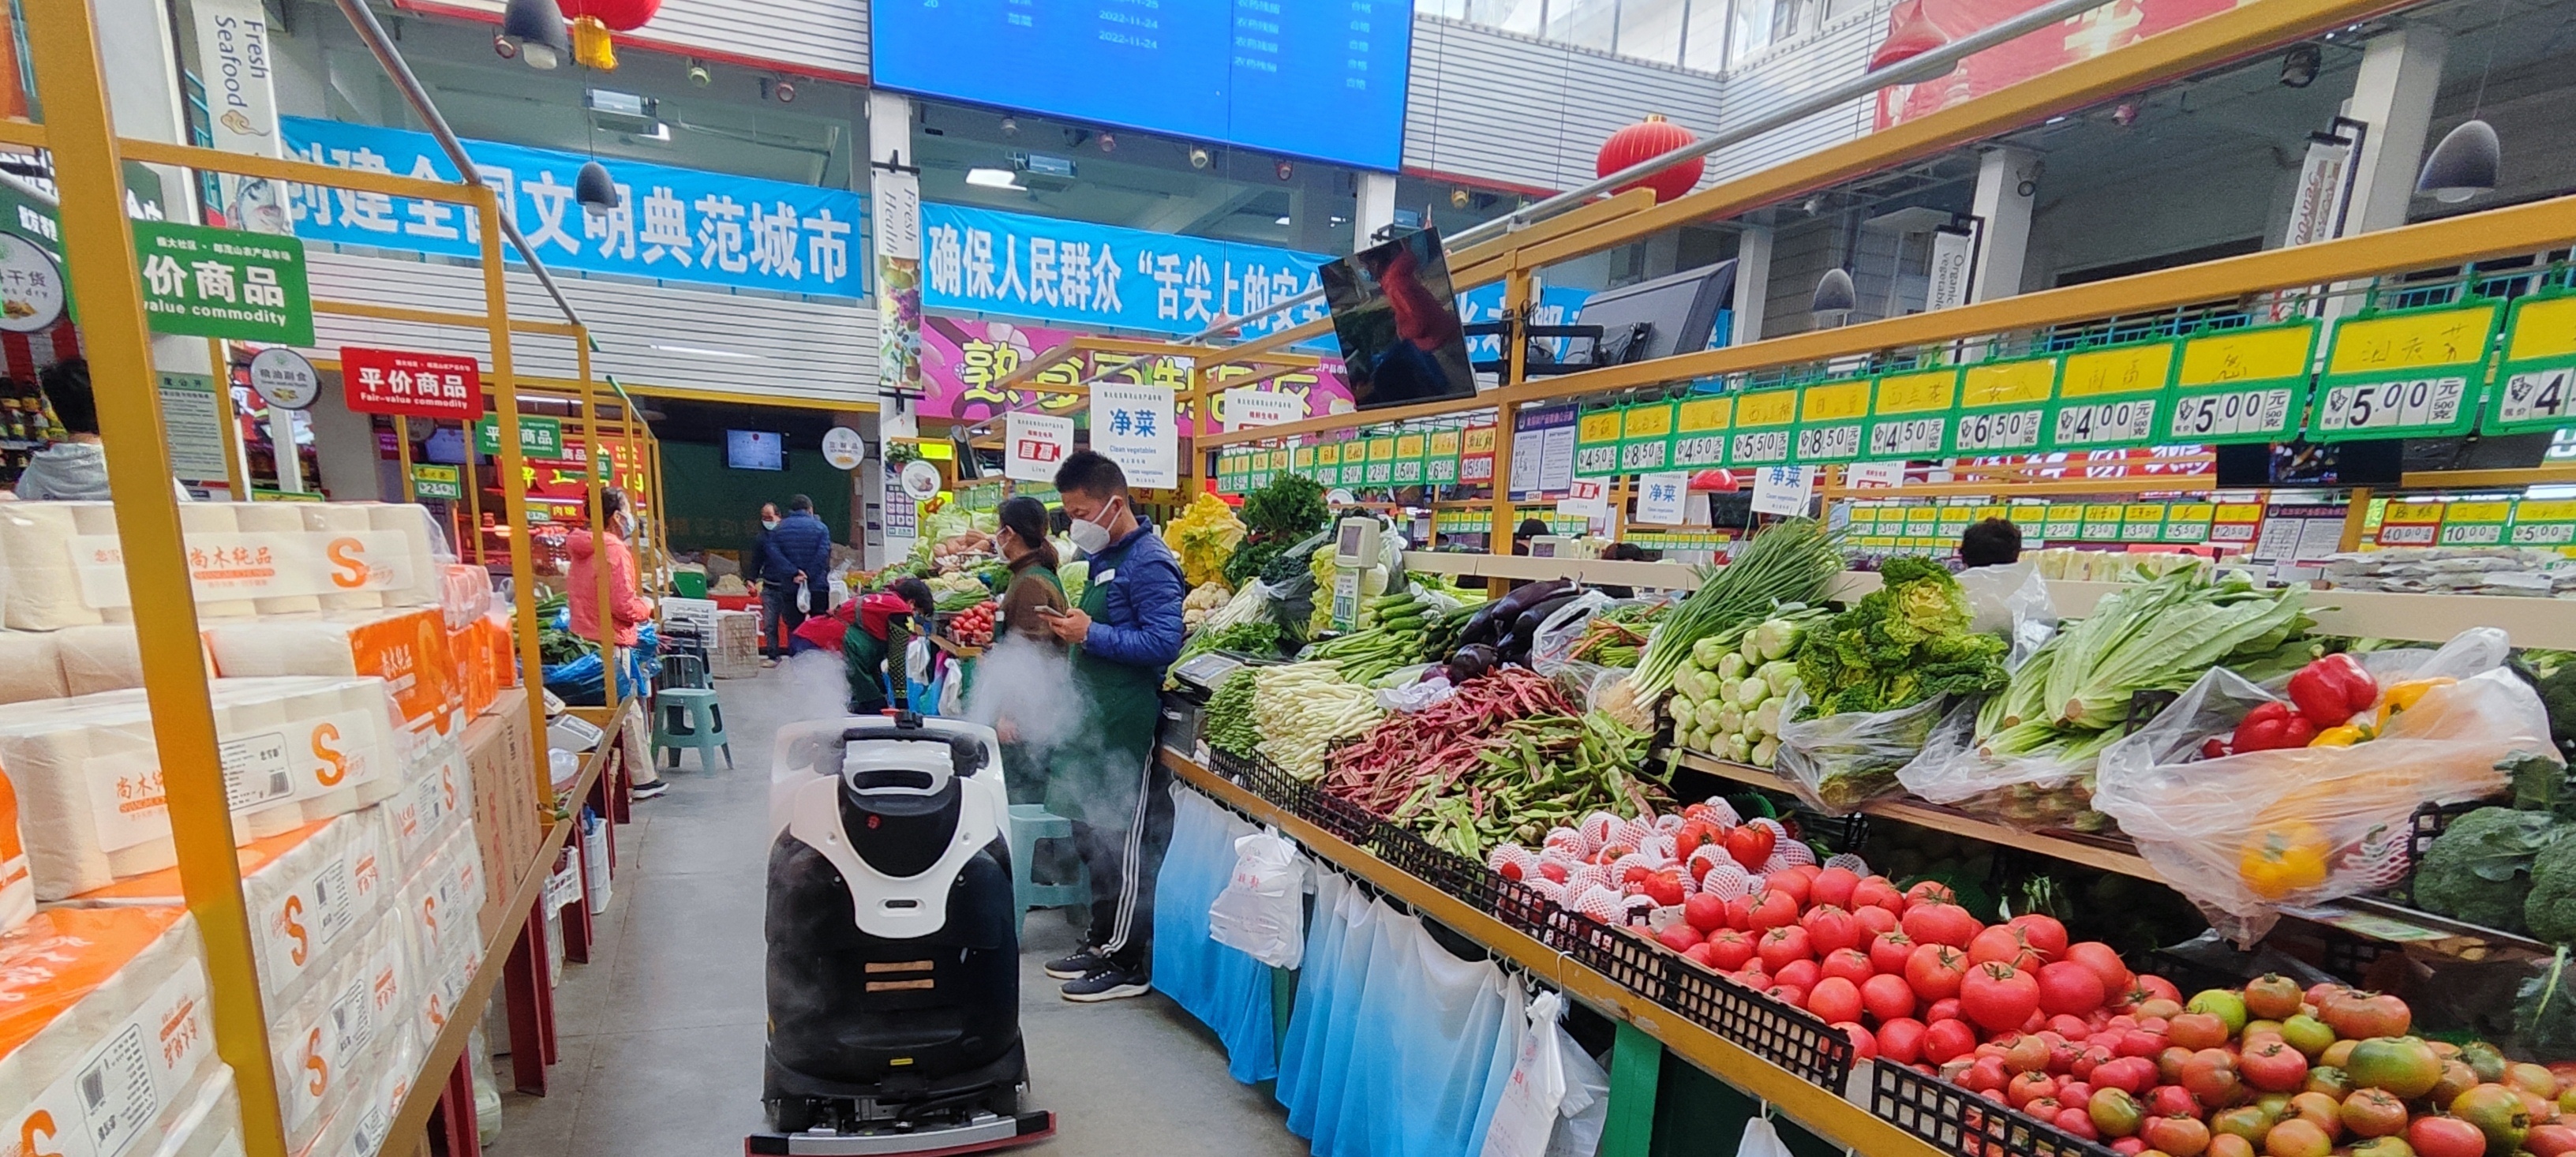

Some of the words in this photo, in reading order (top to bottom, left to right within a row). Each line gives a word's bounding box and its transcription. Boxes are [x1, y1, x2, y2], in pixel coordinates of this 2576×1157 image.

[1099, 10, 1158, 28] 2022-11-24
[244, 20, 266, 80] Fresh
[1099, 31, 1158, 49] 2022-11-24
[215, 15, 247, 108] Seafood
[287, 142, 851, 284] 创建全国文明典范城市
[885, 190, 898, 254] Health
[904, 188, 917, 242] Fresh
[144, 253, 285, 308] 价商品
[1934, 252, 1950, 310] vegetable
[1947, 254, 1965, 305] Organic
[192, 305, 286, 327] commodity
[358, 366, 468, 399] 平价商品
[2267, 391, 2286, 405] 元
[2439, 380, 2460, 395] 元
[414, 398, 468, 410] commodity
[2195, 393, 2260, 433] 5.00
[2349, 381, 2428, 427] 5.00
[485, 425, 552, 446] 平商品
[1108, 407, 1157, 438] 净菜
[1885, 421, 1926, 452] 4.50
[1975, 414, 2020, 443] 6.50
[2076, 404, 2129, 440] 4.00
[1109, 444, 1126, 453] Clean
[1631, 442, 1655, 466] 8.50
[1685, 438, 1712, 462] 4.50
[1744, 433, 1775, 458] 5.50
[1811, 428, 1844, 455] 8.50
[1586, 448, 1608, 470] 4.50
[1648, 483, 1677, 503] 净菜
[189, 545, 272, 569] 尚木纯品
[327, 537, 366, 589] S
[310, 722, 348, 787] S
[442, 763, 455, 811] S
[285, 894, 309, 967] S
[306, 1027, 328, 1098] S
